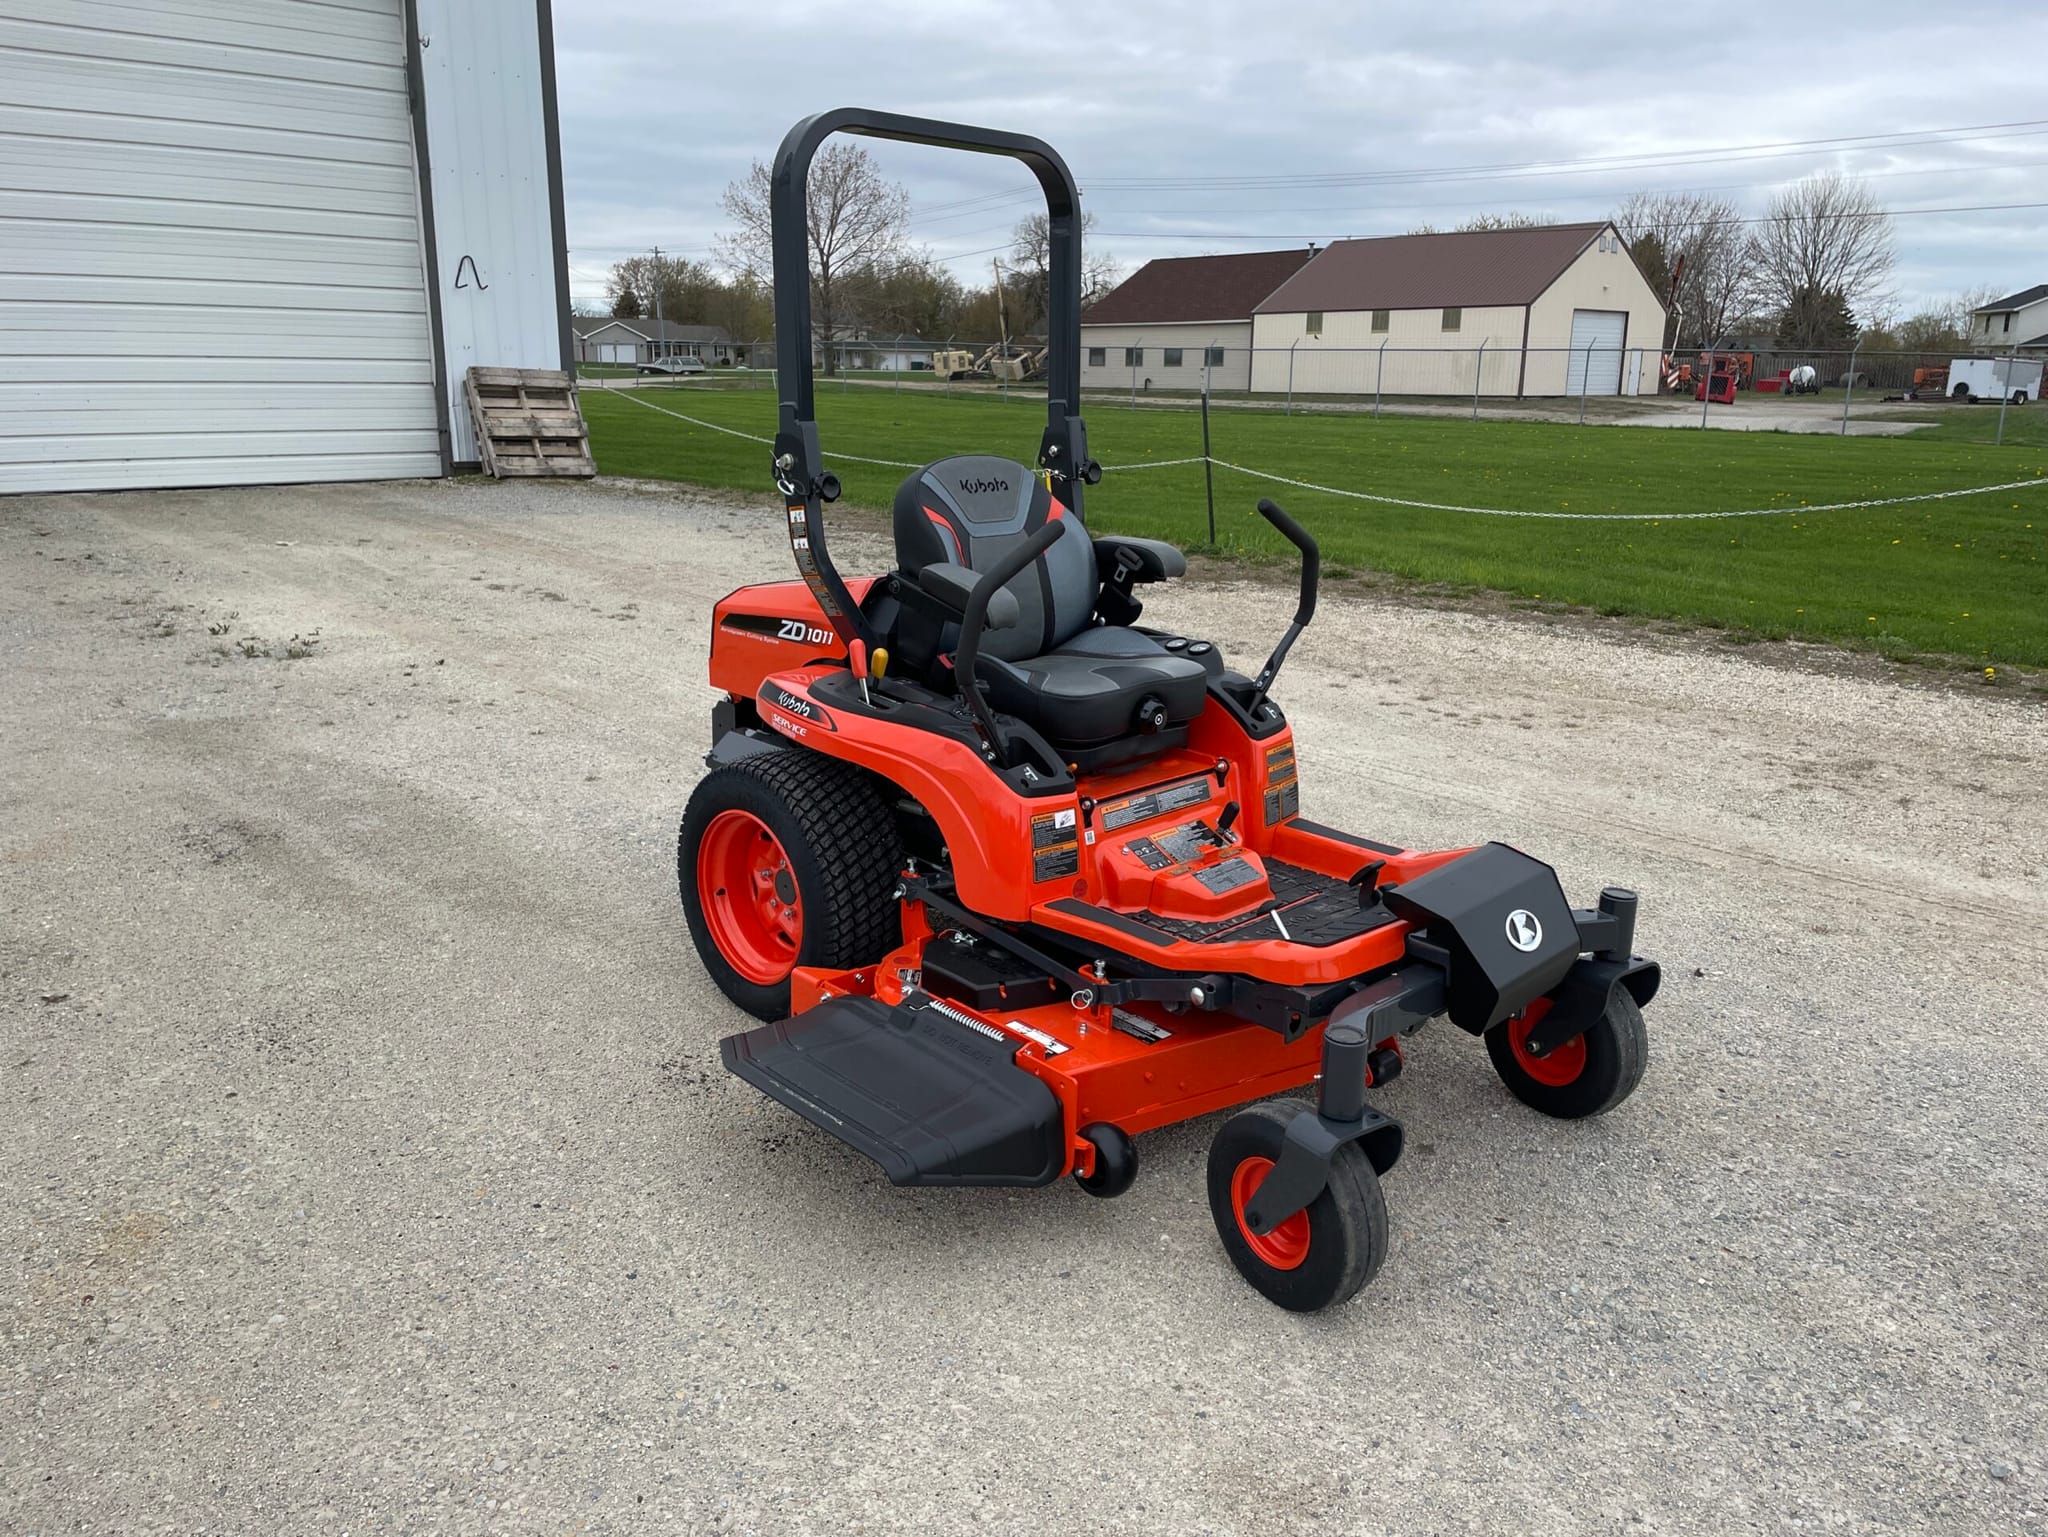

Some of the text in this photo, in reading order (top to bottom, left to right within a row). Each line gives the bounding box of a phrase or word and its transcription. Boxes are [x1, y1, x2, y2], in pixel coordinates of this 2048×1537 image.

[959, 477, 1009, 494] Kubota
[778, 691, 811, 717] Kubota
[772, 713, 808, 736] SERVICE
